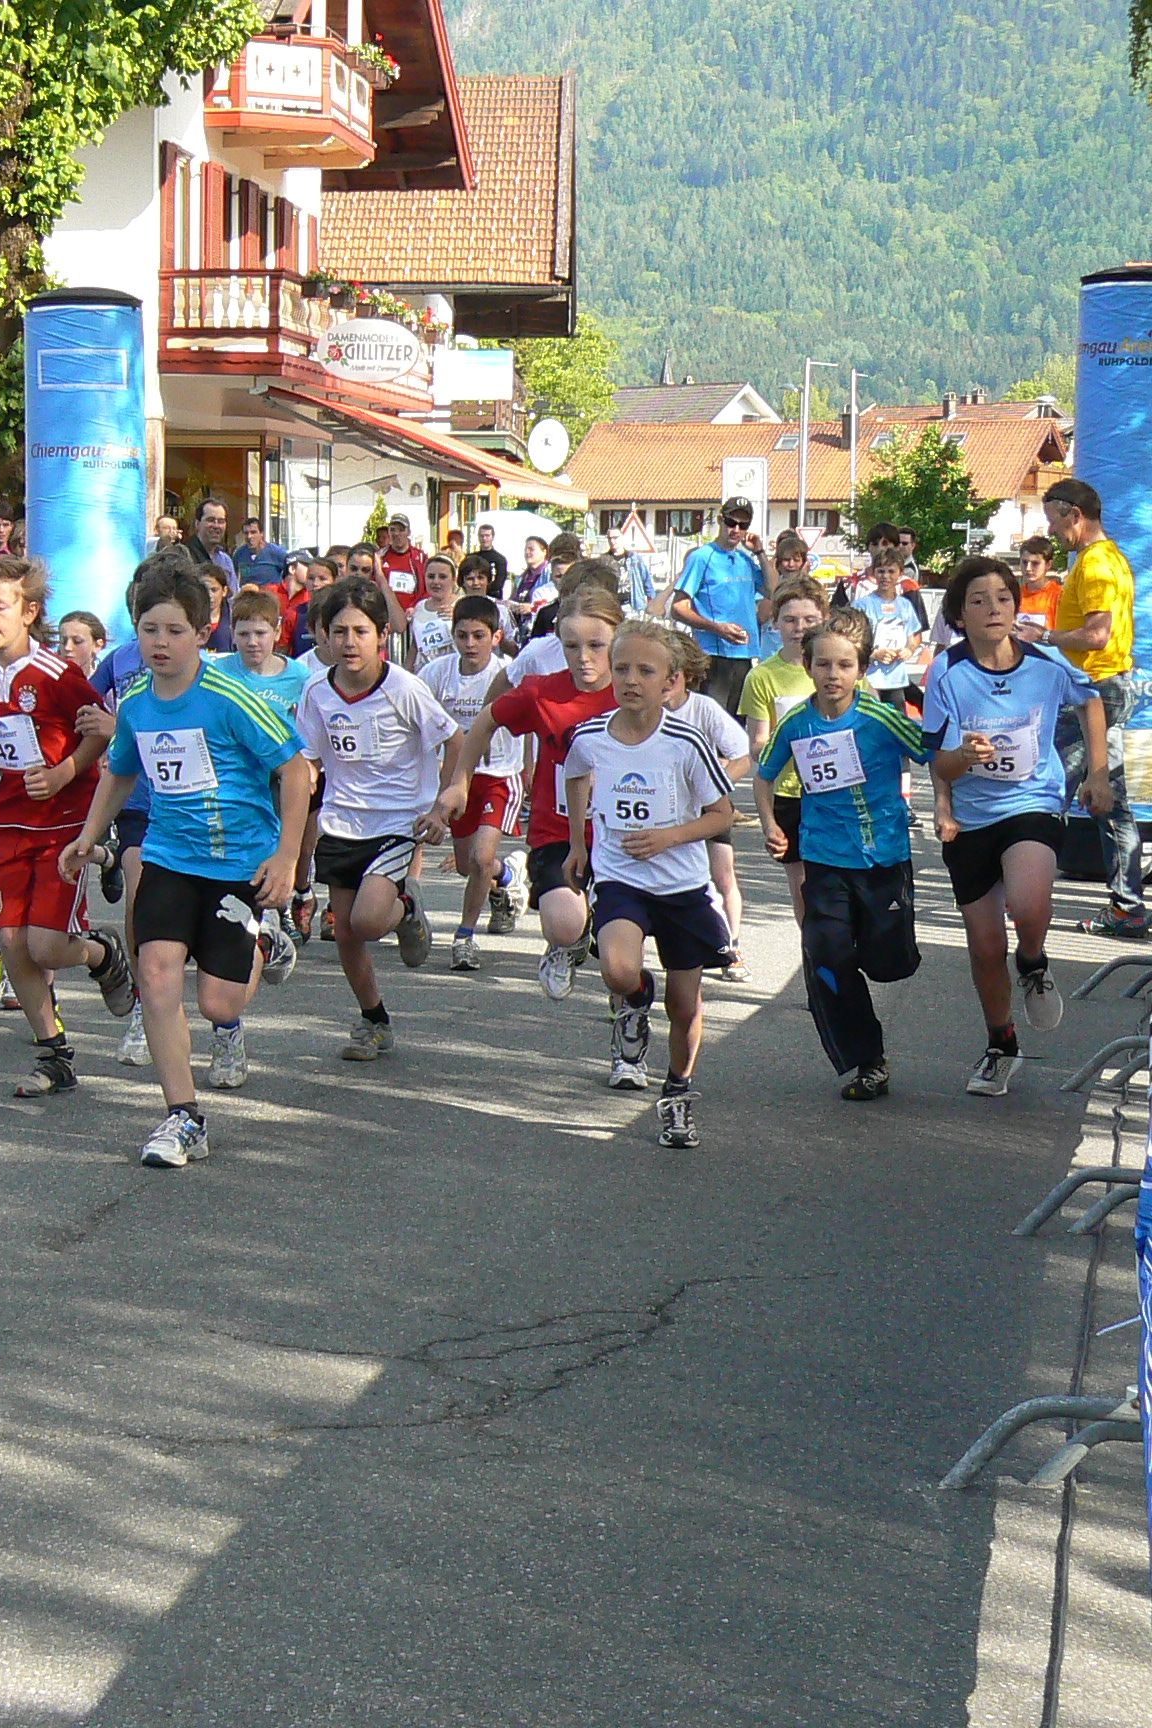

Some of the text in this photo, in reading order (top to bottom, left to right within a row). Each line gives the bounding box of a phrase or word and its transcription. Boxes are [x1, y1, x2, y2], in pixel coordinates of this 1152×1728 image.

[345, 343, 413, 360] GILLITZER
[423, 633, 444, 646] 143
[330, 735, 357, 753] 66
[156, 761, 182, 781] 57
[811, 761, 838, 782] 55
[616, 799, 650, 820] 56
